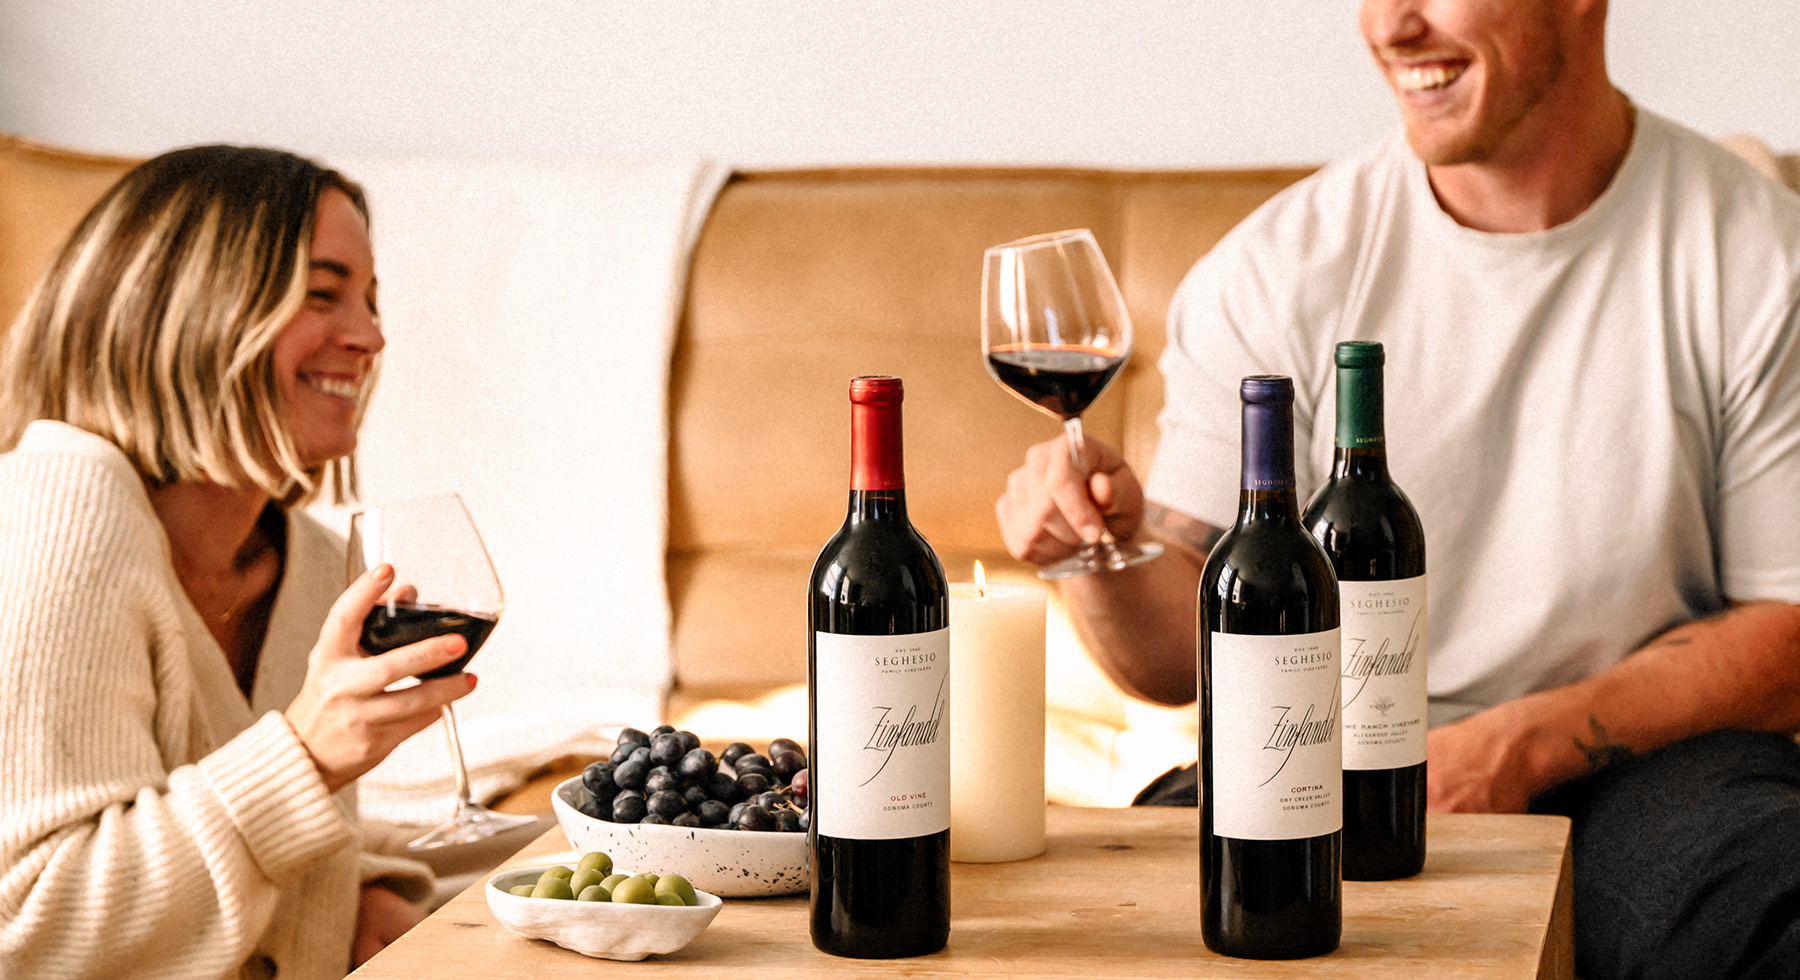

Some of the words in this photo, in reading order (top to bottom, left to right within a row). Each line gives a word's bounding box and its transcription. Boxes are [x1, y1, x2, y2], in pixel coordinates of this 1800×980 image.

[1350, 597, 1410, 609] SEGHESIO
[874, 652, 936, 666] SEGHESIO
[1274, 651, 1332, 666] SEGHESIO
[1341, 605, 1423, 710] Zinfandel
[858, 669, 948, 788] Zinfandel
[1258, 671, 1340, 788] Zinfandel
[1290, 784, 1324, 793] CORTINA
[890, 794, 908, 802] OLD
[909, 792, 927, 800] VINE
[912, 801, 933, 809] COUNTY
